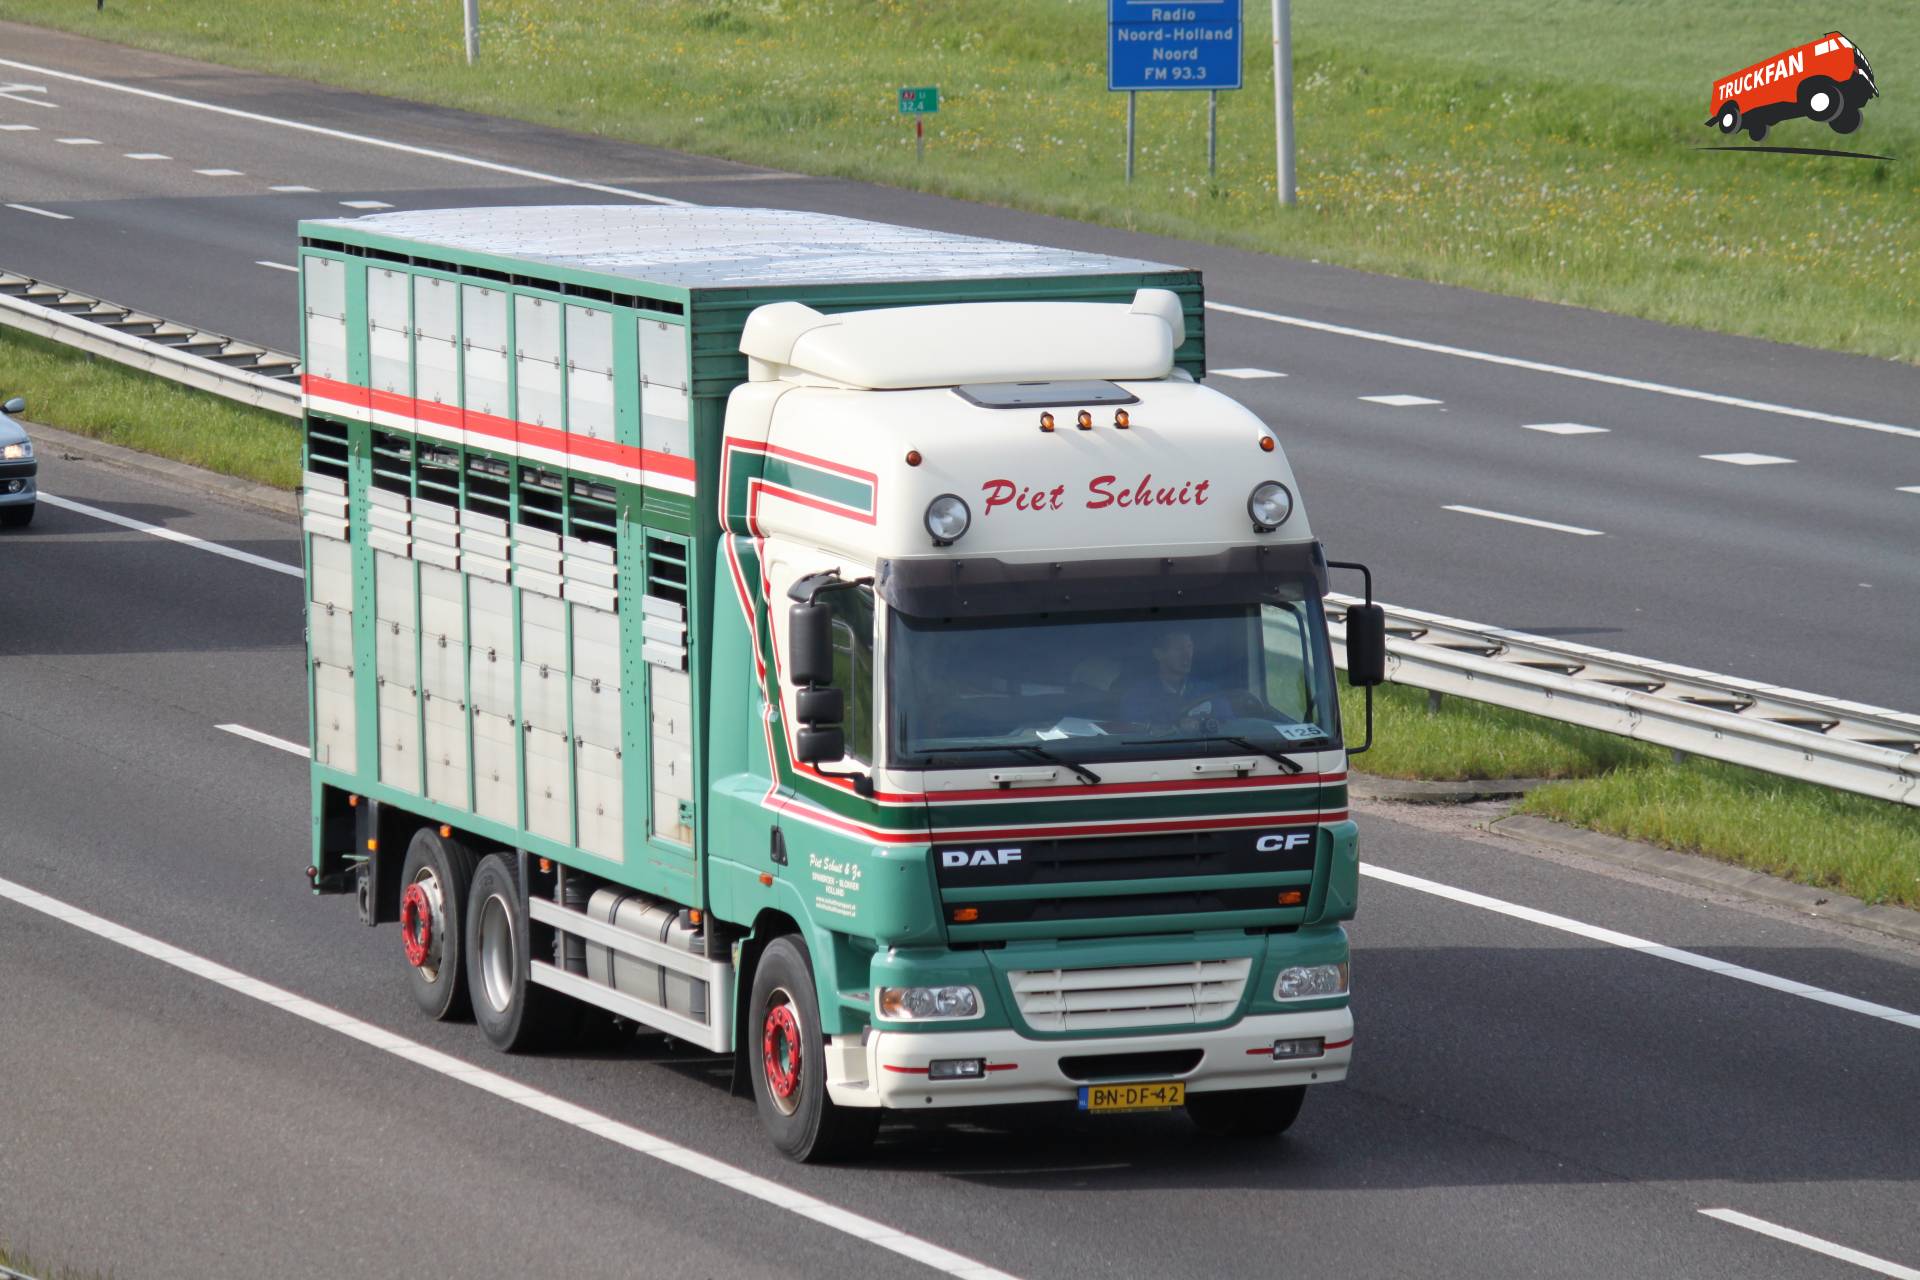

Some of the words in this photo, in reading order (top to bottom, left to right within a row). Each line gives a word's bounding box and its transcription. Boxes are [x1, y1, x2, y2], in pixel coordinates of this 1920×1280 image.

[1152, 8, 1196, 21] Radio
[1118, 27, 1233, 41] Noord-Holland
[1152, 47, 1198, 60] Noord
[1144, 67, 1167, 80] FM
[1172, 67, 1207, 80] 93.3
[981, 479, 1065, 516] Piet
[1086, 473, 1210, 509] Schuit
[1284, 727, 1321, 738] 125
[1256, 833, 1310, 852] CF
[942, 848, 1022, 867] DAF
[1094, 1086, 1178, 1106] BN-DF-42
